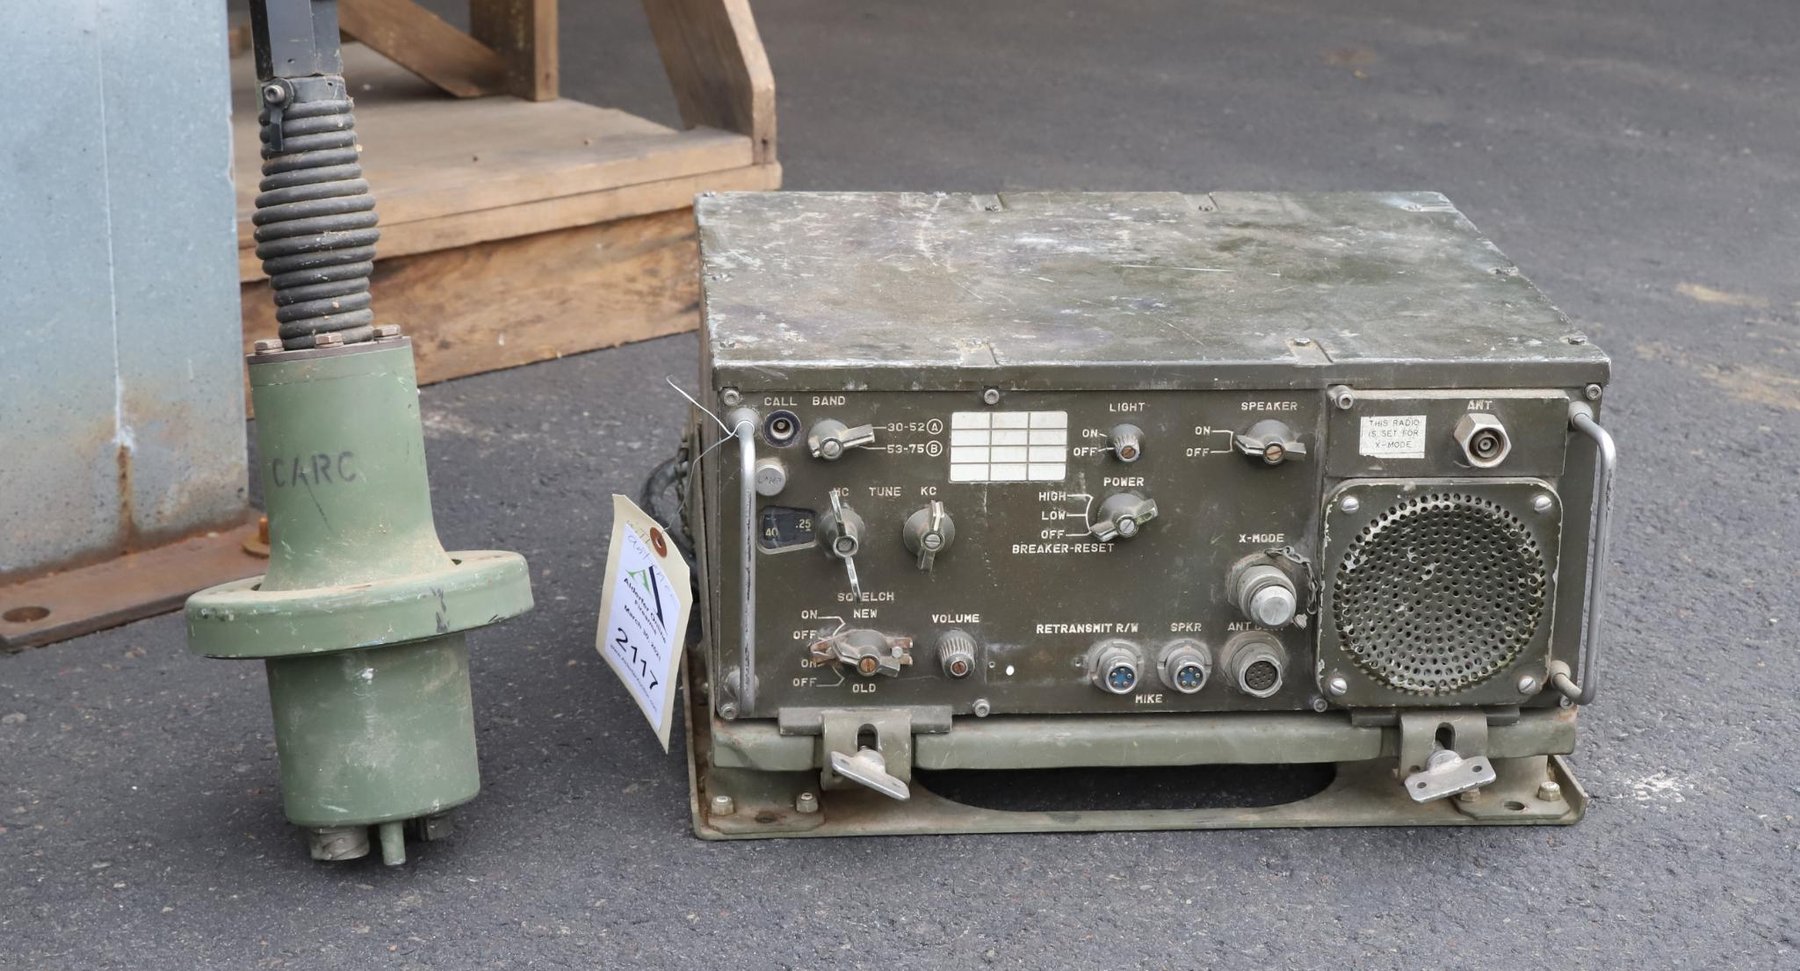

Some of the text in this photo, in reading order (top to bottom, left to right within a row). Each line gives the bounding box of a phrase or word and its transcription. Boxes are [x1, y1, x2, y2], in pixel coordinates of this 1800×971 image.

[764, 397, 798, 406] CALL
[812, 396, 846, 406] BAND
[1467, 400, 1493, 410] ANT
[1109, 402, 1145, 412] LIGHT
[1241, 401, 1298, 411] SPEAKER
[887, 422, 926, 432] 30-52
[1195, 426, 1211, 435] ON
[1082, 429, 1098, 438] ON
[887, 444, 925, 454] 53-75
[1073, 448, 1096, 457] OFF
[1186, 448, 1209, 457] OFF
[272, 451, 356, 488] CARC
[1103, 477, 1144, 487] POWER
[869, 487, 901, 497] TUNE
[921, 487, 937, 496] KC
[1038, 492, 1066, 501] HIGH
[1041, 511, 1066, 520] LOW
[766, 528, 778, 537] 40
[1041, 530, 1065, 539] OFF
[1239, 534, 1284, 543] X-MODE
[1012, 543, 1114, 554] BREAKER-RESET
[837, 592, 894, 602] SQELCH
[801, 610, 818, 619] ON
[853, 609, 878, 618] NEW
[932, 614, 980, 623] VOLUME
[1036, 623, 1139, 634] RETRANSMIT R/W
[1170, 623, 1202, 632] SPKR
[1227, 622, 1251, 631] ANT
[793, 631, 818, 640] OFF
[616, 628, 658, 690] 2117
[801, 659, 817, 668] ON
[793, 678, 817, 687] OFF
[852, 684, 876, 693] OLD
[1135, 694, 1162, 704] MIKE
